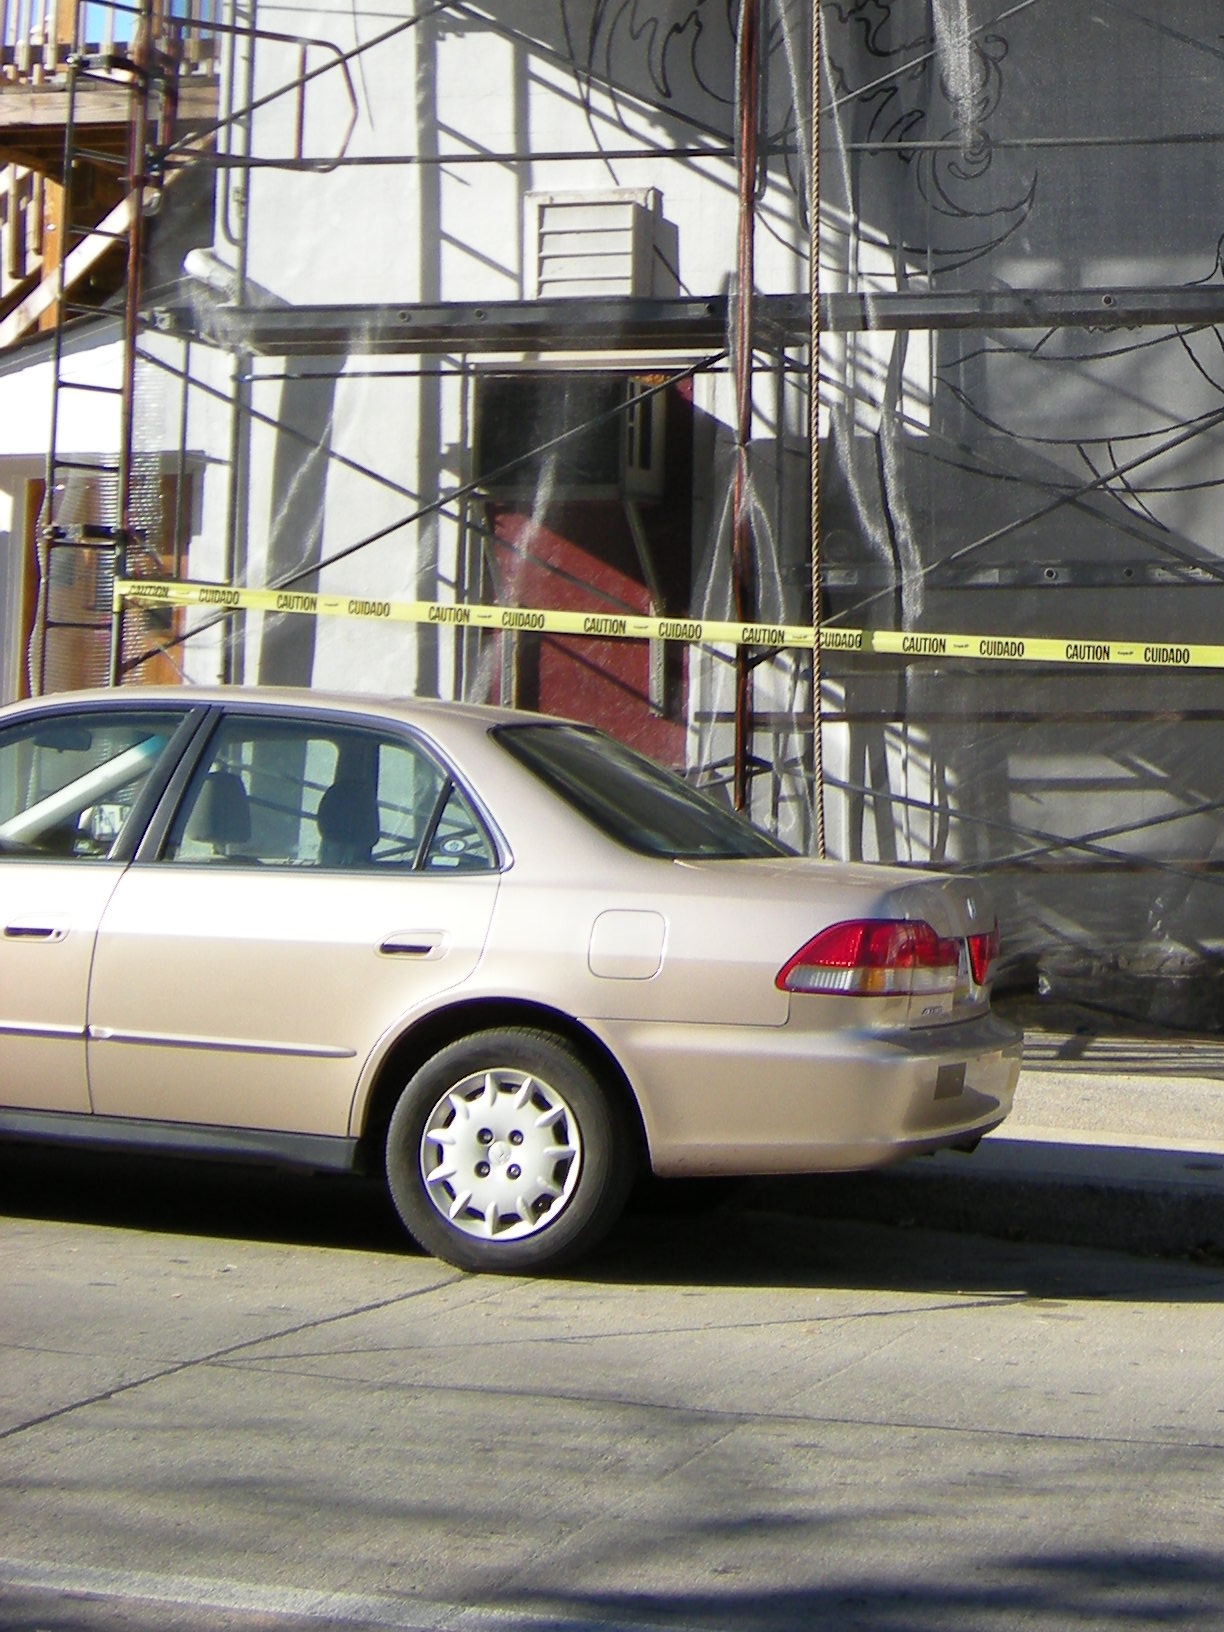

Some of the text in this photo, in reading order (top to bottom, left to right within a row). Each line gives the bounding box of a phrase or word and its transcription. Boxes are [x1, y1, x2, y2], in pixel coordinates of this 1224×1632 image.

[199, 587, 240, 606] CUIDADO
[276, 593, 317, 611] CAUTION
[347, 599, 391, 618] CUIDADO
[428, 605, 470, 623] CAUTION
[501, 610, 545, 629] CUIDADO
[583, 616, 627, 635] CAUTION
[658, 621, 702, 640] CUIDADO
[741, 627, 785, 645] CAUTION
[819, 630, 862, 650] CUIDADO
[902, 636, 946, 654] CAUTION
[979, 639, 1025, 657] CUIDADO
[1065, 643, 1110, 661] CAUTION
[1143, 646, 1190, 664] CUIDADO
